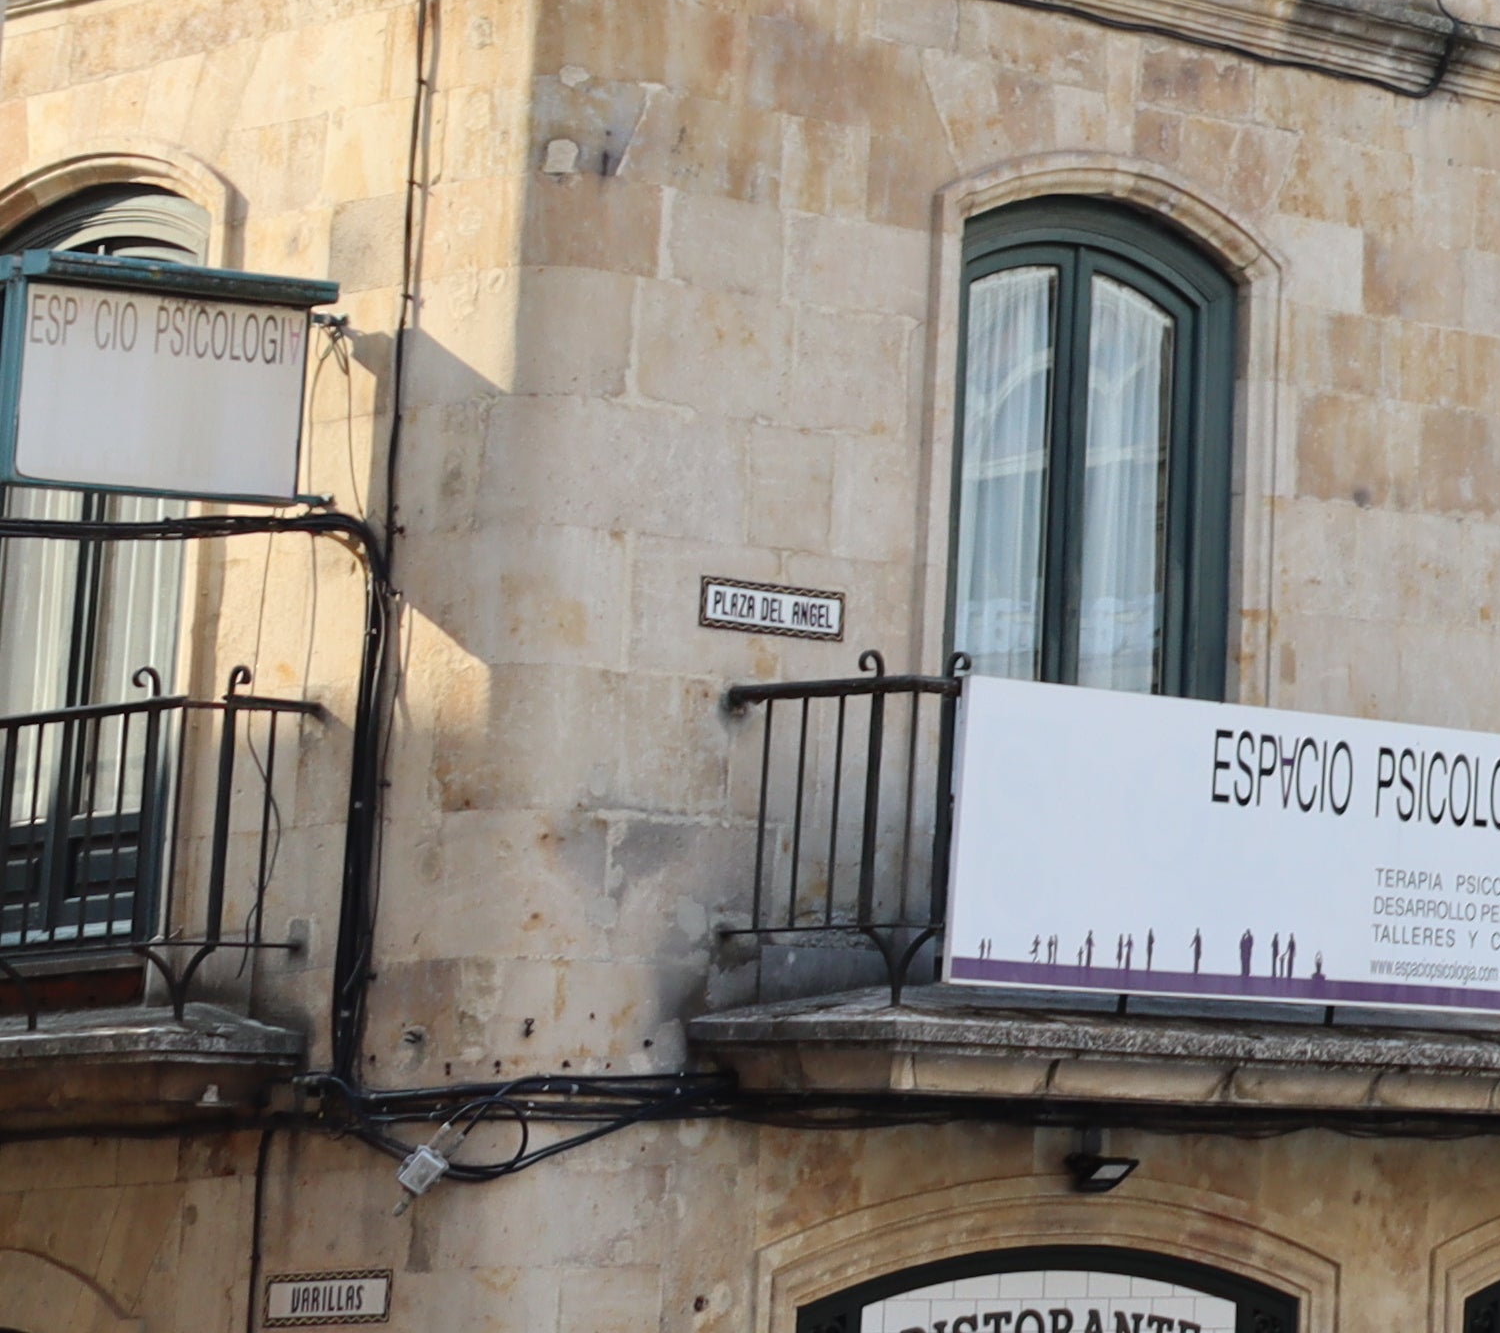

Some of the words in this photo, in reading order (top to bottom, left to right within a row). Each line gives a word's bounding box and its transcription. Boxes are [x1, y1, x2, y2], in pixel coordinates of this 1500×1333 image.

[712, 590, 756, 619] PLAZA
[760, 597, 785, 623] DEL
[791, 601, 833, 629] ANGEL
[1375, 868, 1443, 891] TERAPIA
[1373, 896, 1477, 922] DESARROLLO
[1373, 924, 1456, 948] TALLERES
[1467, 930, 1479, 949] Y
[290, 1284, 364, 1313] VARILLAS
